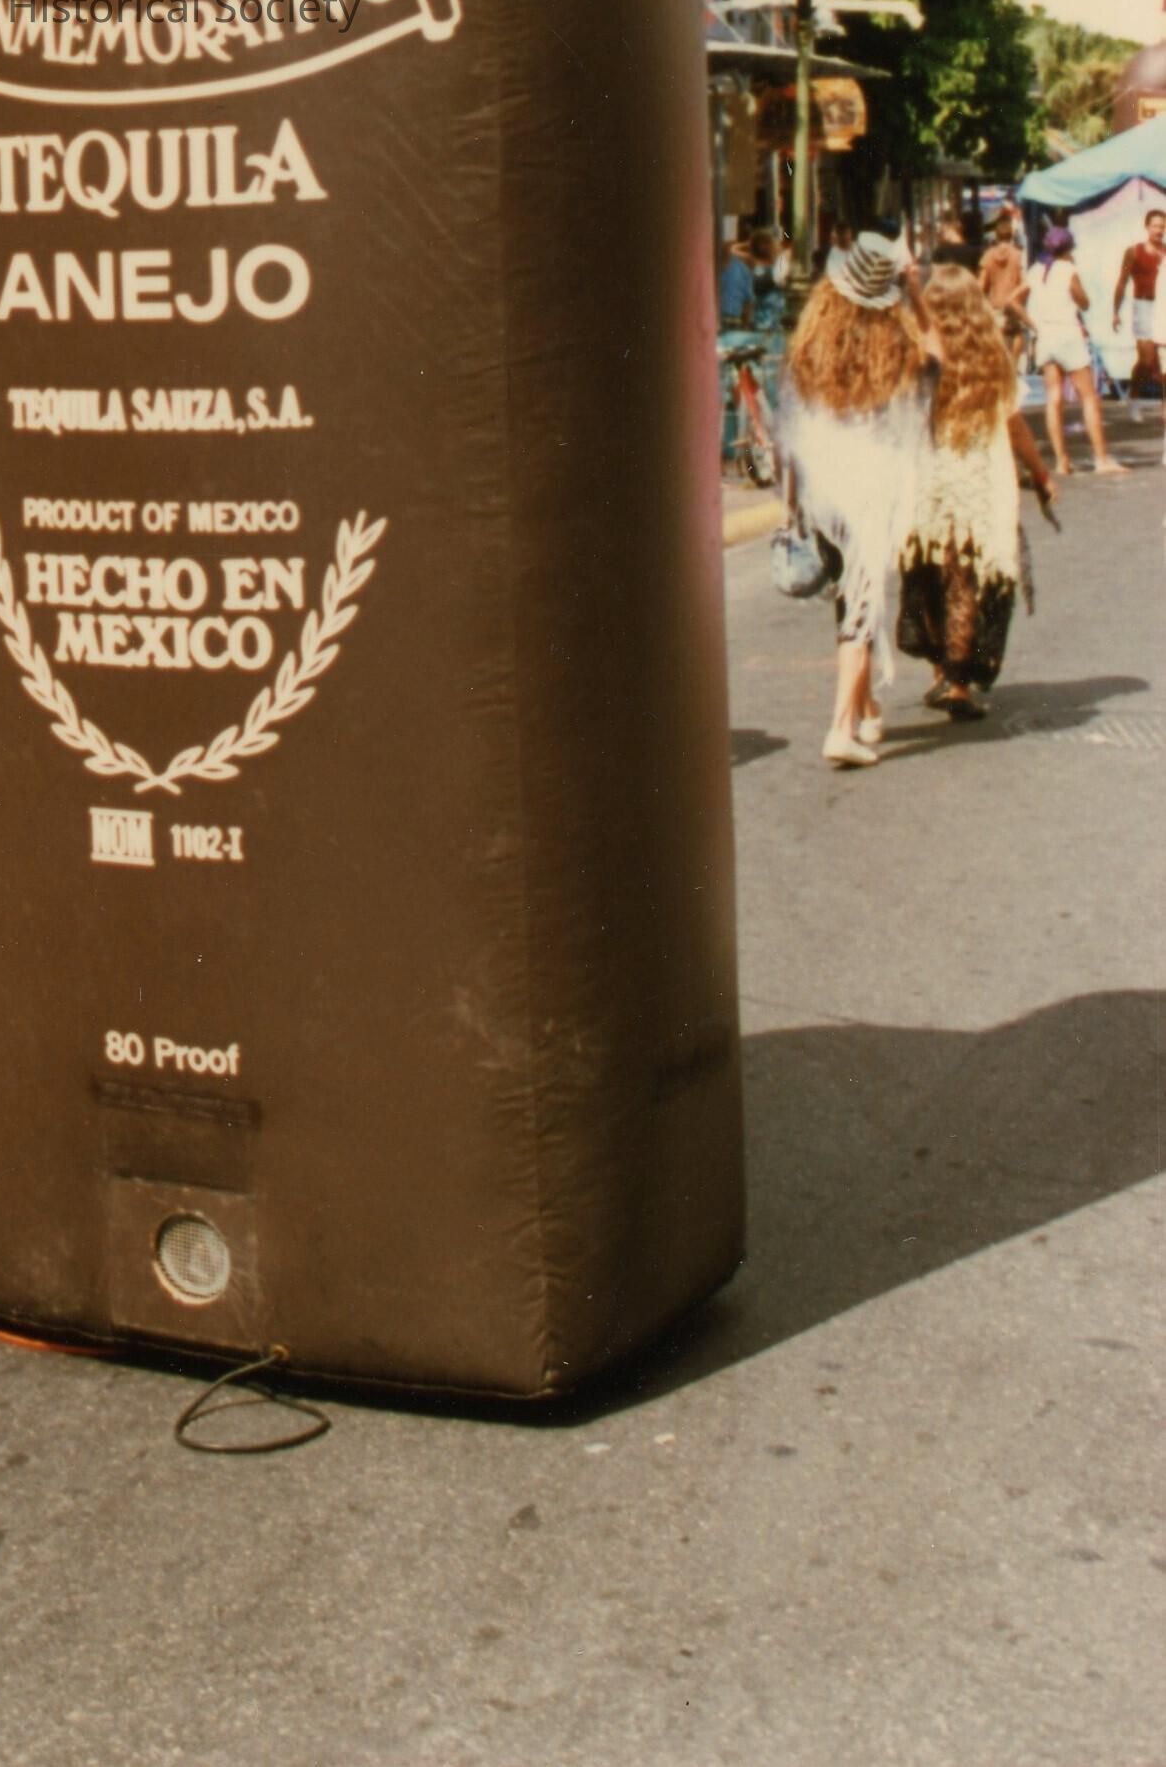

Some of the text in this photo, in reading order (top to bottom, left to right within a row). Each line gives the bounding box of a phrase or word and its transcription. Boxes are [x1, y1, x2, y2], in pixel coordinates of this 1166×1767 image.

[7, 387, 127, 436] TEQUILA
[247, 384, 315, 431] S.A.
[23, 497, 301, 532] PRODUCT OF MEXICO
[24, 552, 306, 612] HECHO EN
[53, 611, 274, 671] MEXICO
[89, 807, 154, 866] NOM
[104, 1030, 241, 1076] 80 Proof
